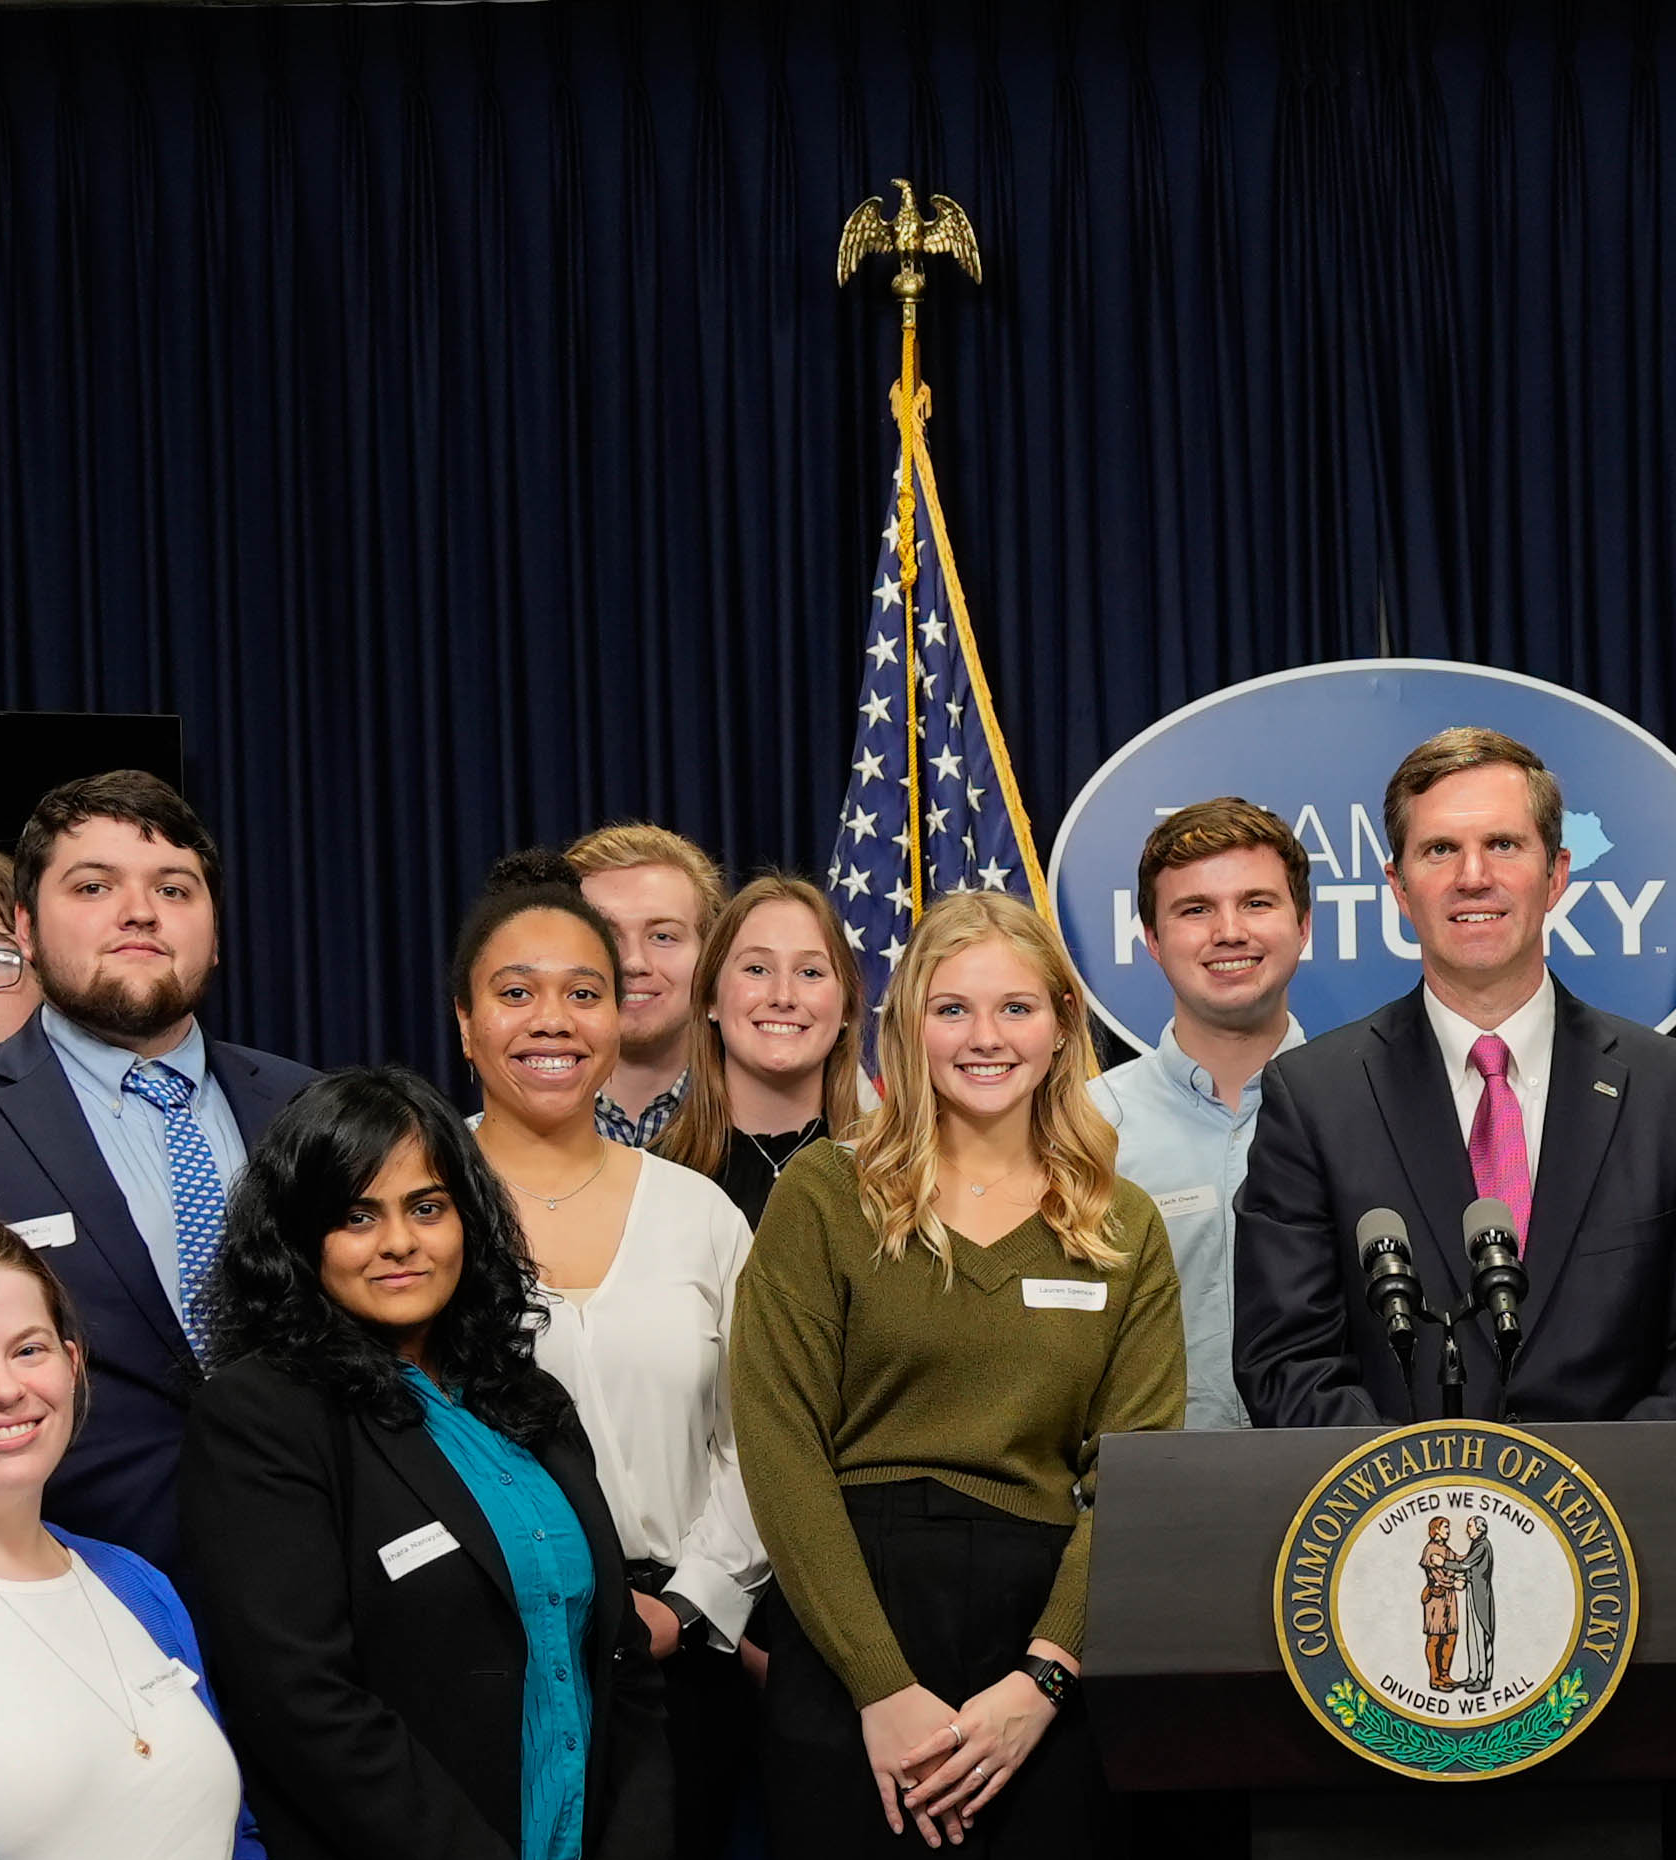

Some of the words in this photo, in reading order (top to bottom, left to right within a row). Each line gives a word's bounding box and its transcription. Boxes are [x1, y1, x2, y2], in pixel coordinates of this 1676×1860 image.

[1378, 1494, 1441, 1537] UNITED
[1447, 1492, 1474, 1509] WE
[1479, 1494, 1536, 1536] STAND
[1291, 1435, 1484, 1658] COMMONWEALTH
[1497, 1445, 1549, 1486] OF
[1542, 1475, 1623, 1665] KENTUCKY
[1379, 1674, 1450, 1715] DIVIDED
[1459, 1695, 1488, 1715] WE
[1493, 1675, 1535, 1710] FALL
